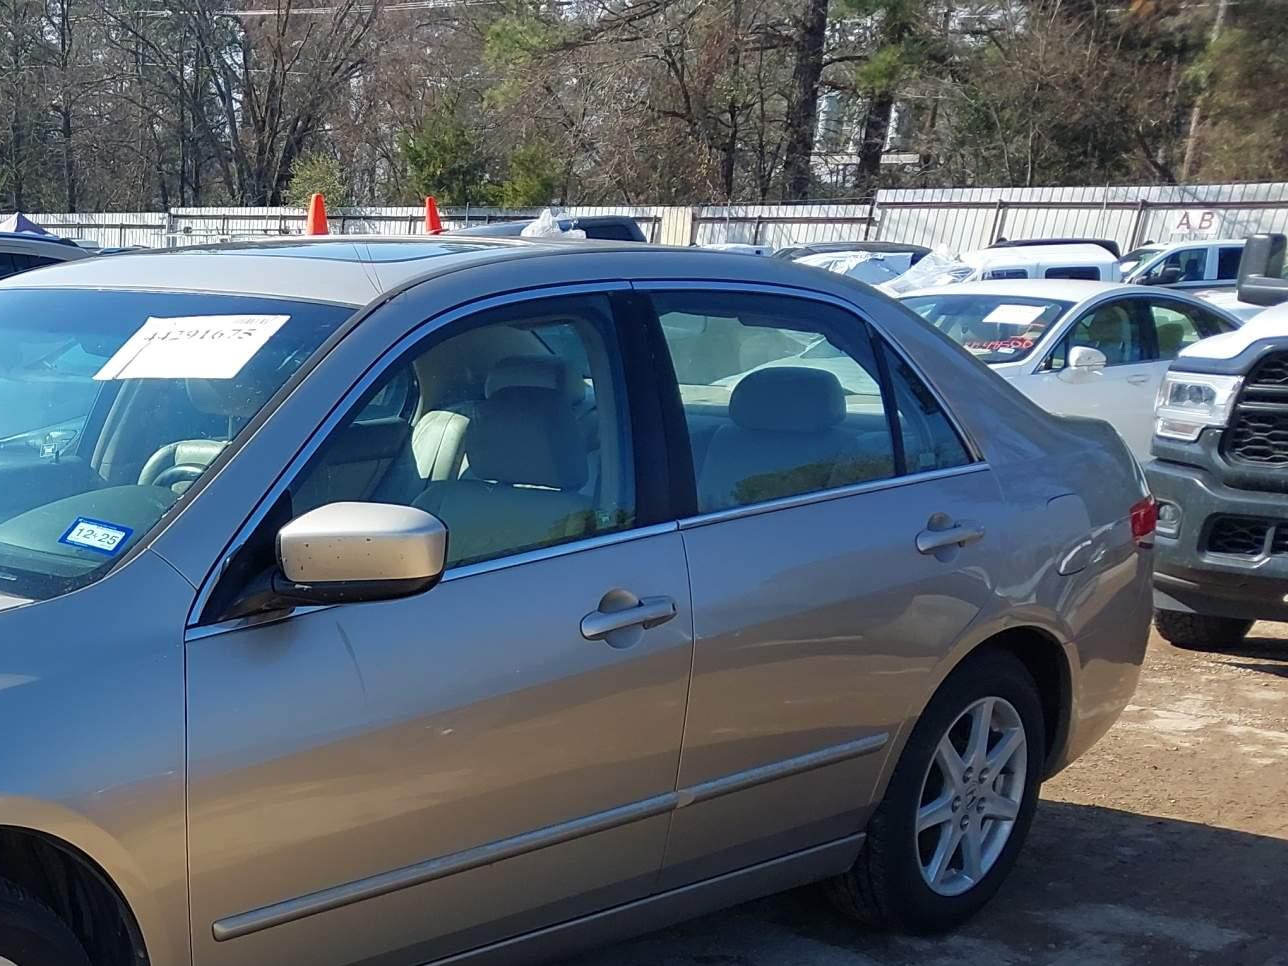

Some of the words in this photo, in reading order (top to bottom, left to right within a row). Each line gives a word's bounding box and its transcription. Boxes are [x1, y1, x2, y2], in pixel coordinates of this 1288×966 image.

[1175, 210, 1192, 230] A
[1198, 210, 1215, 230] B
[143, 327, 257, 342] 44291675
